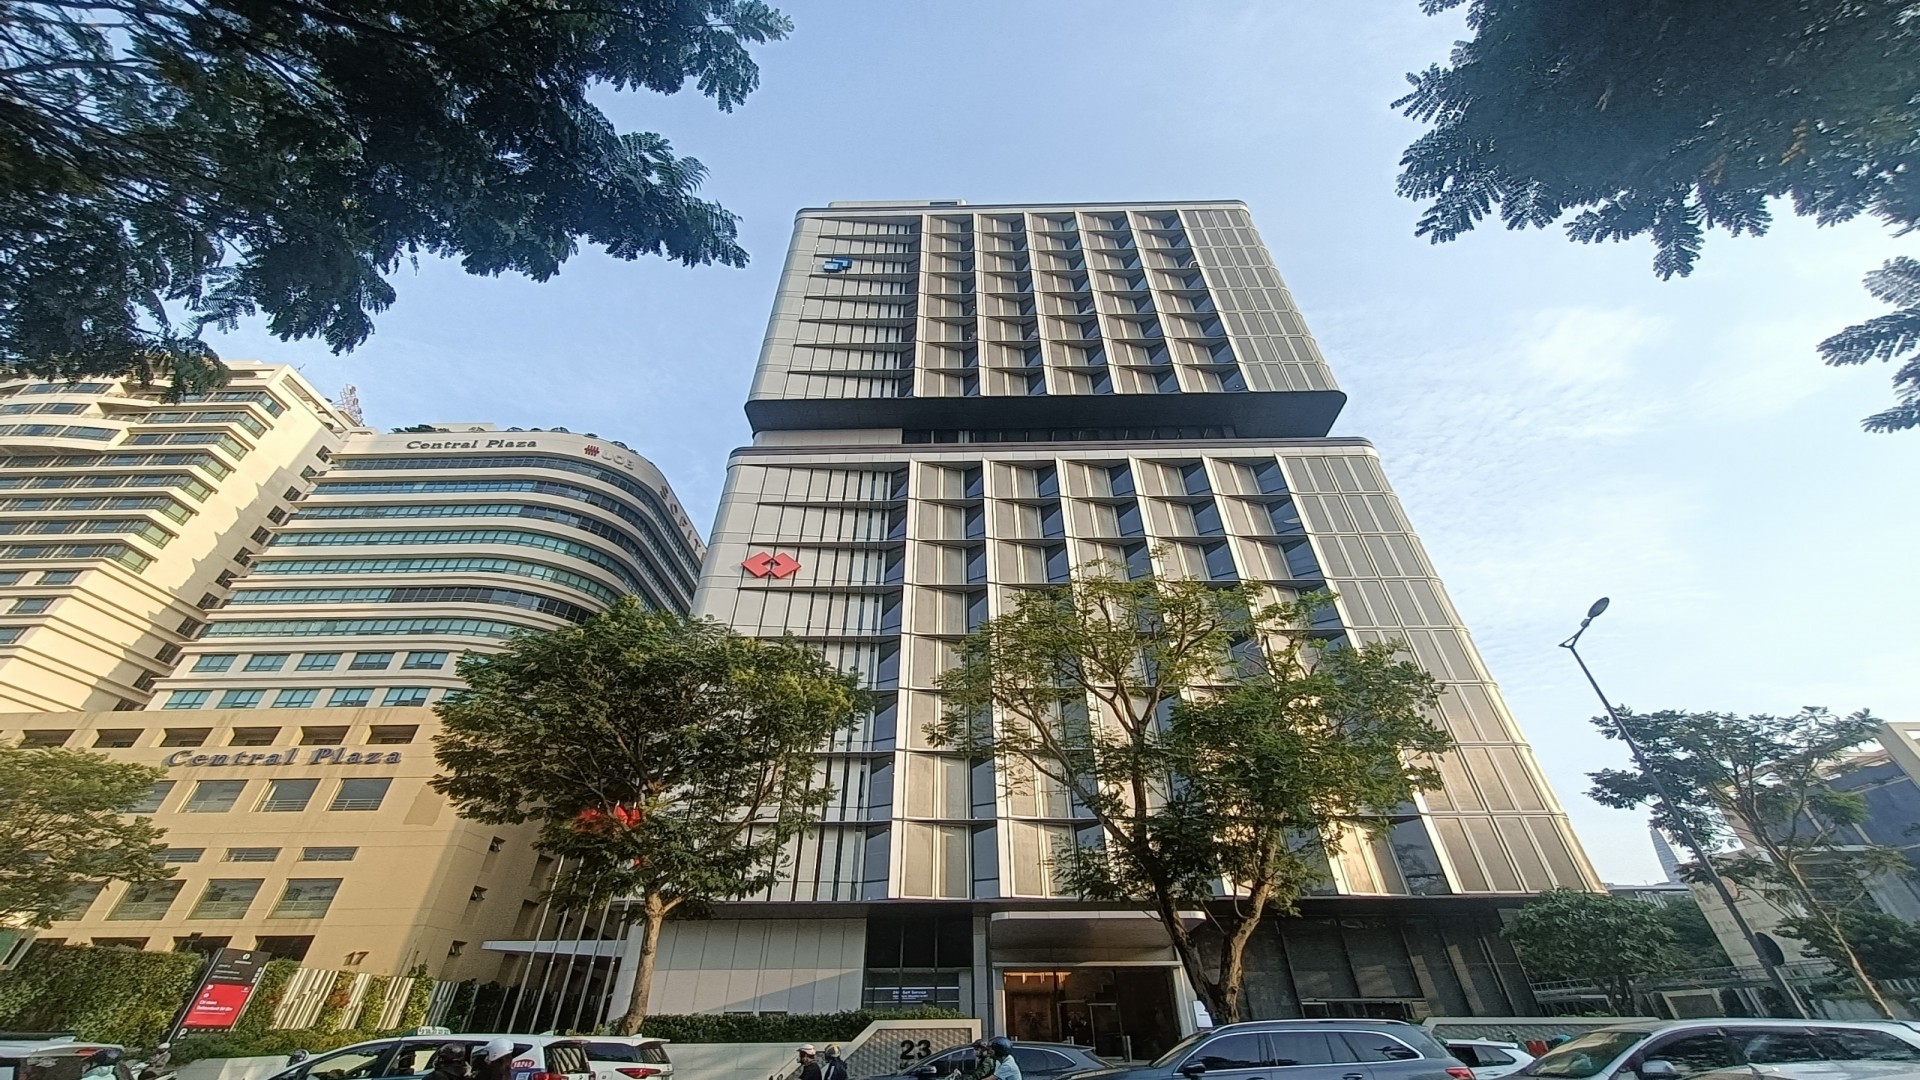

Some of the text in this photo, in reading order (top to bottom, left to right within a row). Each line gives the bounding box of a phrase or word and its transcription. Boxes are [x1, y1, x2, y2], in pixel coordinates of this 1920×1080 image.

[406, 439, 537, 450] Central Plaza
[601, 449, 634, 470] UOB
[166, 747, 402, 767] Central Plaza
[343, 951, 370, 966] 17
[900, 1040, 931, 1060] 23
